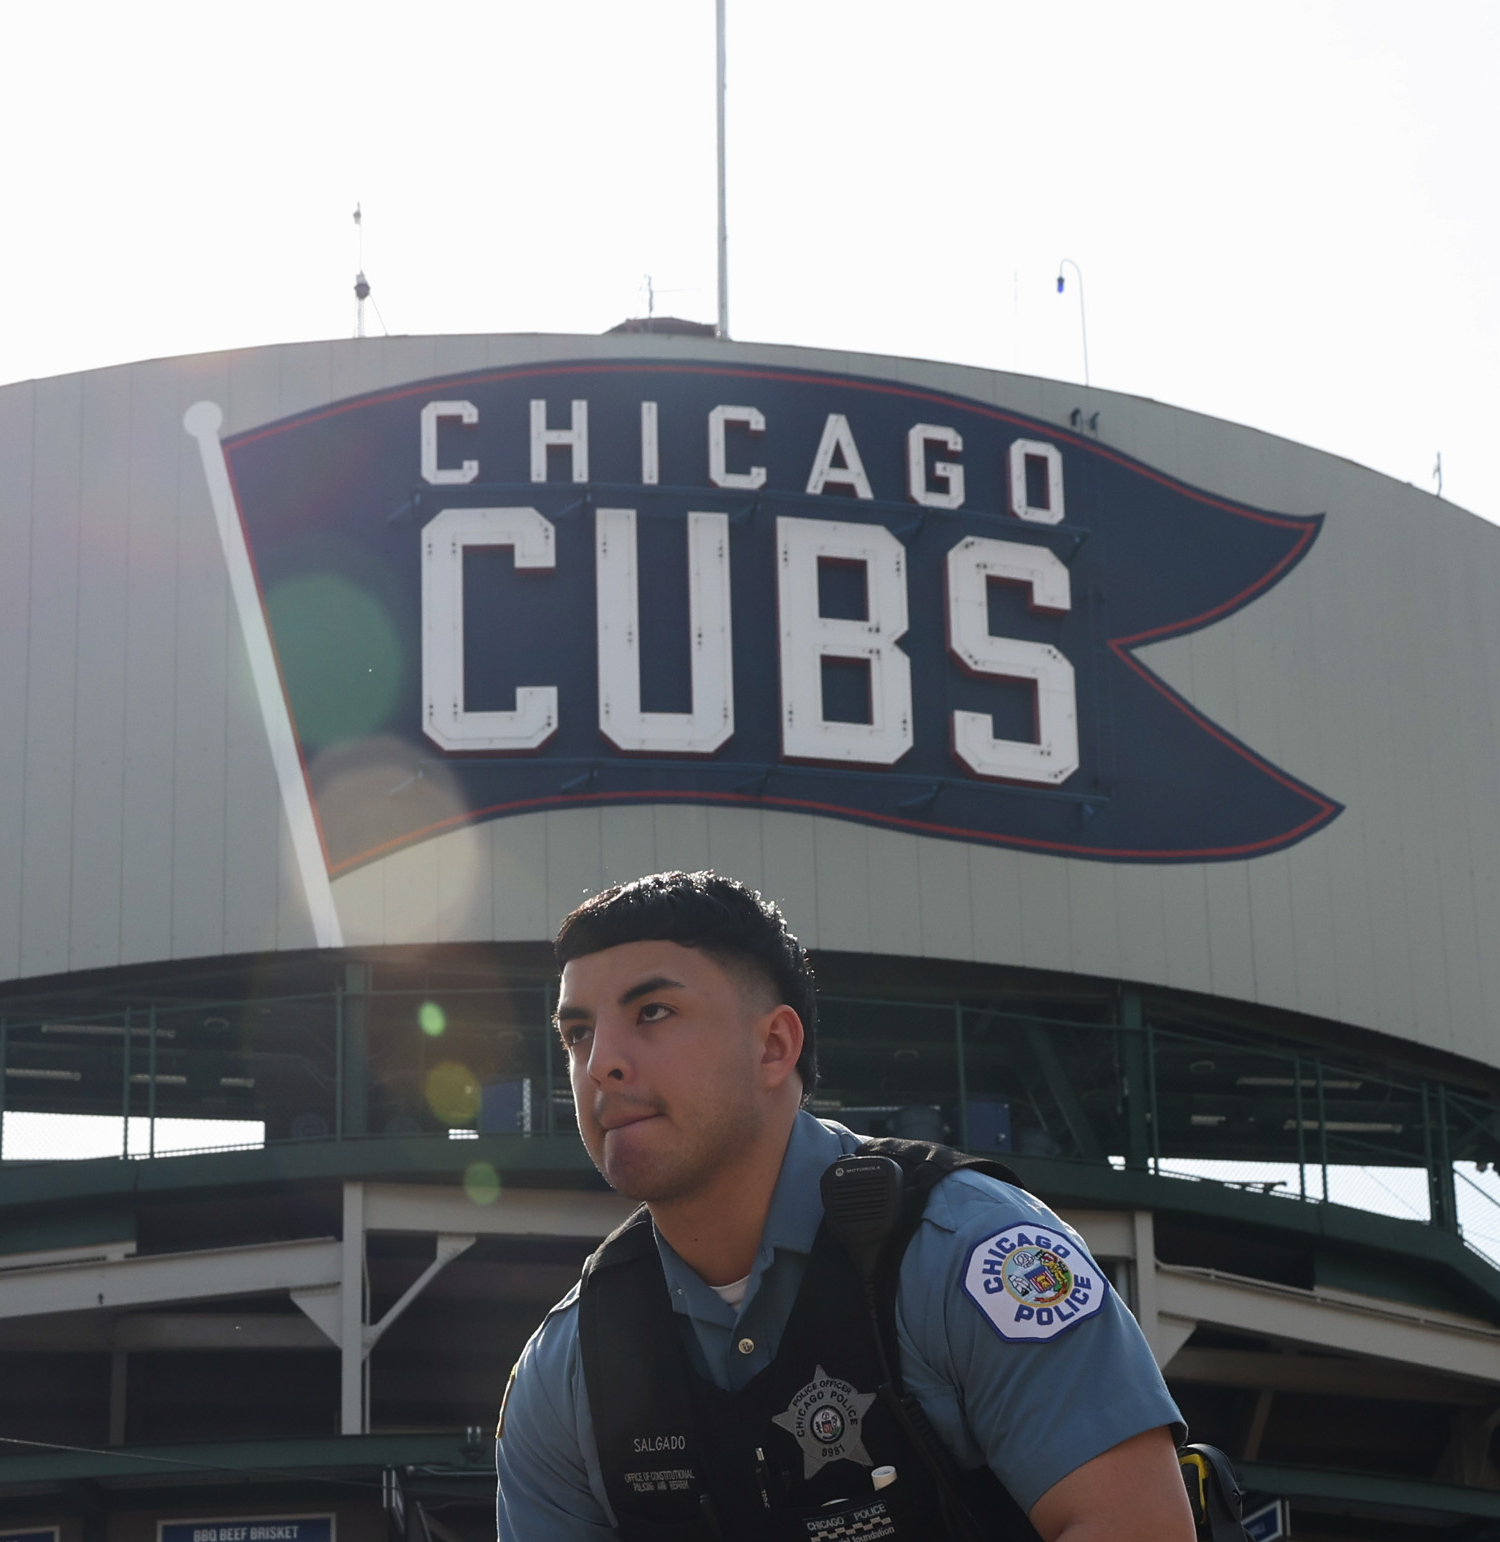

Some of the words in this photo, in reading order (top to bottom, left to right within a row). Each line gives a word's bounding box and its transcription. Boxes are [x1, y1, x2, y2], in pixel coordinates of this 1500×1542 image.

[420, 400, 1065, 525] CHICAGO
[421, 506, 1080, 785] CUBS
[982, 1232, 1071, 1294] CHICAGO
[1014, 1274, 1092, 1326] POLICE
[792, 1383, 817, 1407] POLICE
[820, 1380, 852, 1395] OFFICER
[796, 1391, 824, 1437] CHICAGO
[830, 1391, 858, 1426] POLICE
[633, 1435, 686, 1453] SALGADO
[822, 1444, 845, 1457] 8981
[624, 1472, 643, 1483] OFFICE
[651, 1469, 695, 1481] CONSTITUTIONAL
[806, 1517, 845, 1531] CHICAGO
[854, 1503, 887, 1521] POLICE
[193, 1529, 217, 1542] BBQ
[219, 1527, 247, 1542] BEEF
[250, 1525, 300, 1541] BRISKET
